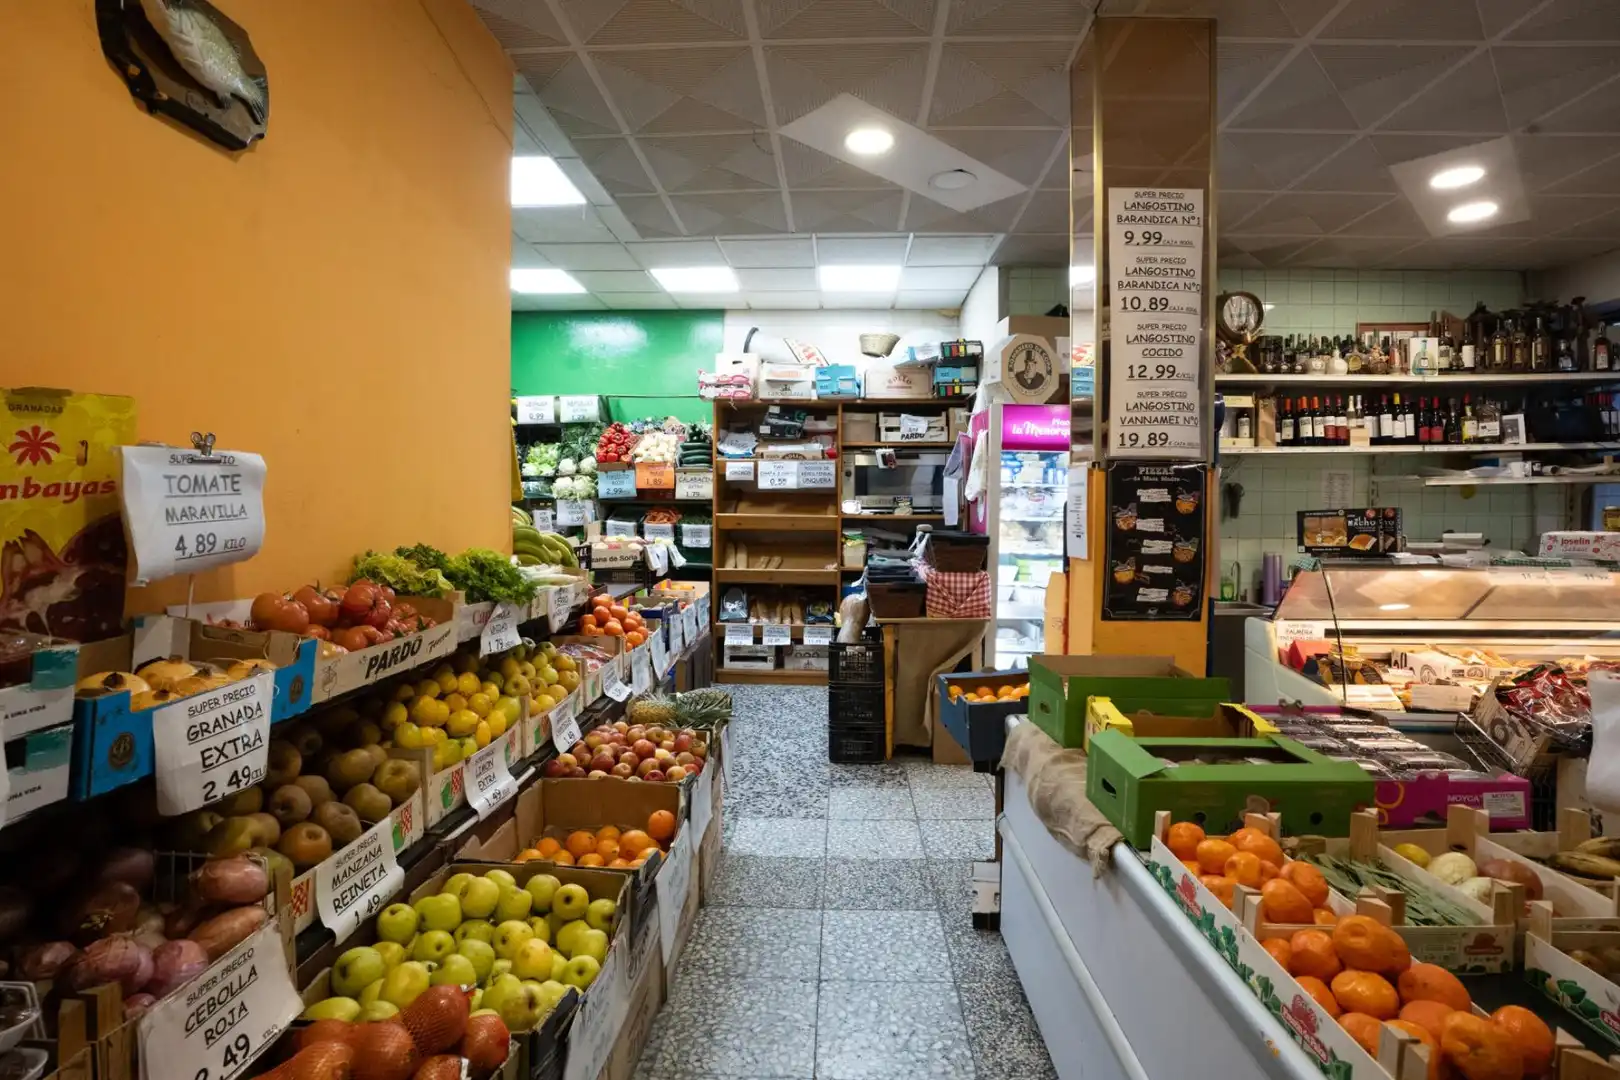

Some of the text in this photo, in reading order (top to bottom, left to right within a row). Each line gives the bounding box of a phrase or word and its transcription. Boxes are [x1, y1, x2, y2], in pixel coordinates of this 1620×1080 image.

[1134, 191, 1157, 199] SUPER
[1123, 201, 1195, 211] LANGOSTINO
[1116, 214, 1178, 224] BARANDICA
[1136, 256, 1187, 265] SUPER PRECIO
[1125, 266, 1196, 277] LANGOSTINO
[1117, 280, 1180, 290] BARANDICA
[1120, 296, 1169, 313] 10,89
[1161, 323, 1188, 331] PRECIO
[1126, 334, 1196, 344] LANGOSTINO
[1141, 348, 1184, 357] COCIDO
[1127, 364, 1176, 380] 12,99
[1136, 391, 1188, 399] SUPER PRECIO
[1125, 401, 1195, 412] LANGOSTINO
[1119, 415, 1180, 425] VANNAMEI
[1118, 432, 1169, 448] 19,89
[162, 474, 242, 494] TOMATE
[165, 503, 248, 523] MARAVILLA
[174, 532, 247, 559] 4,89 KILO
[364, 635, 423, 679] PARDO
[187, 684, 257, 717] SUPER PRECIO
[29, 704, 47, 714] VIDA
[186, 701, 263, 742] GRANADA
[200, 728, 263, 769] EXTRA
[24, 784, 42, 795] VIDA
[202, 765, 252, 802] 2,49
[331, 844, 383, 890] MANZANA
[332, 862, 387, 914] REINETA
[186, 947, 255, 1006] SUPER PRECIO
[184, 964, 258, 1033] CEBOLLA
[203, 1000, 248, 1046] ROJA
